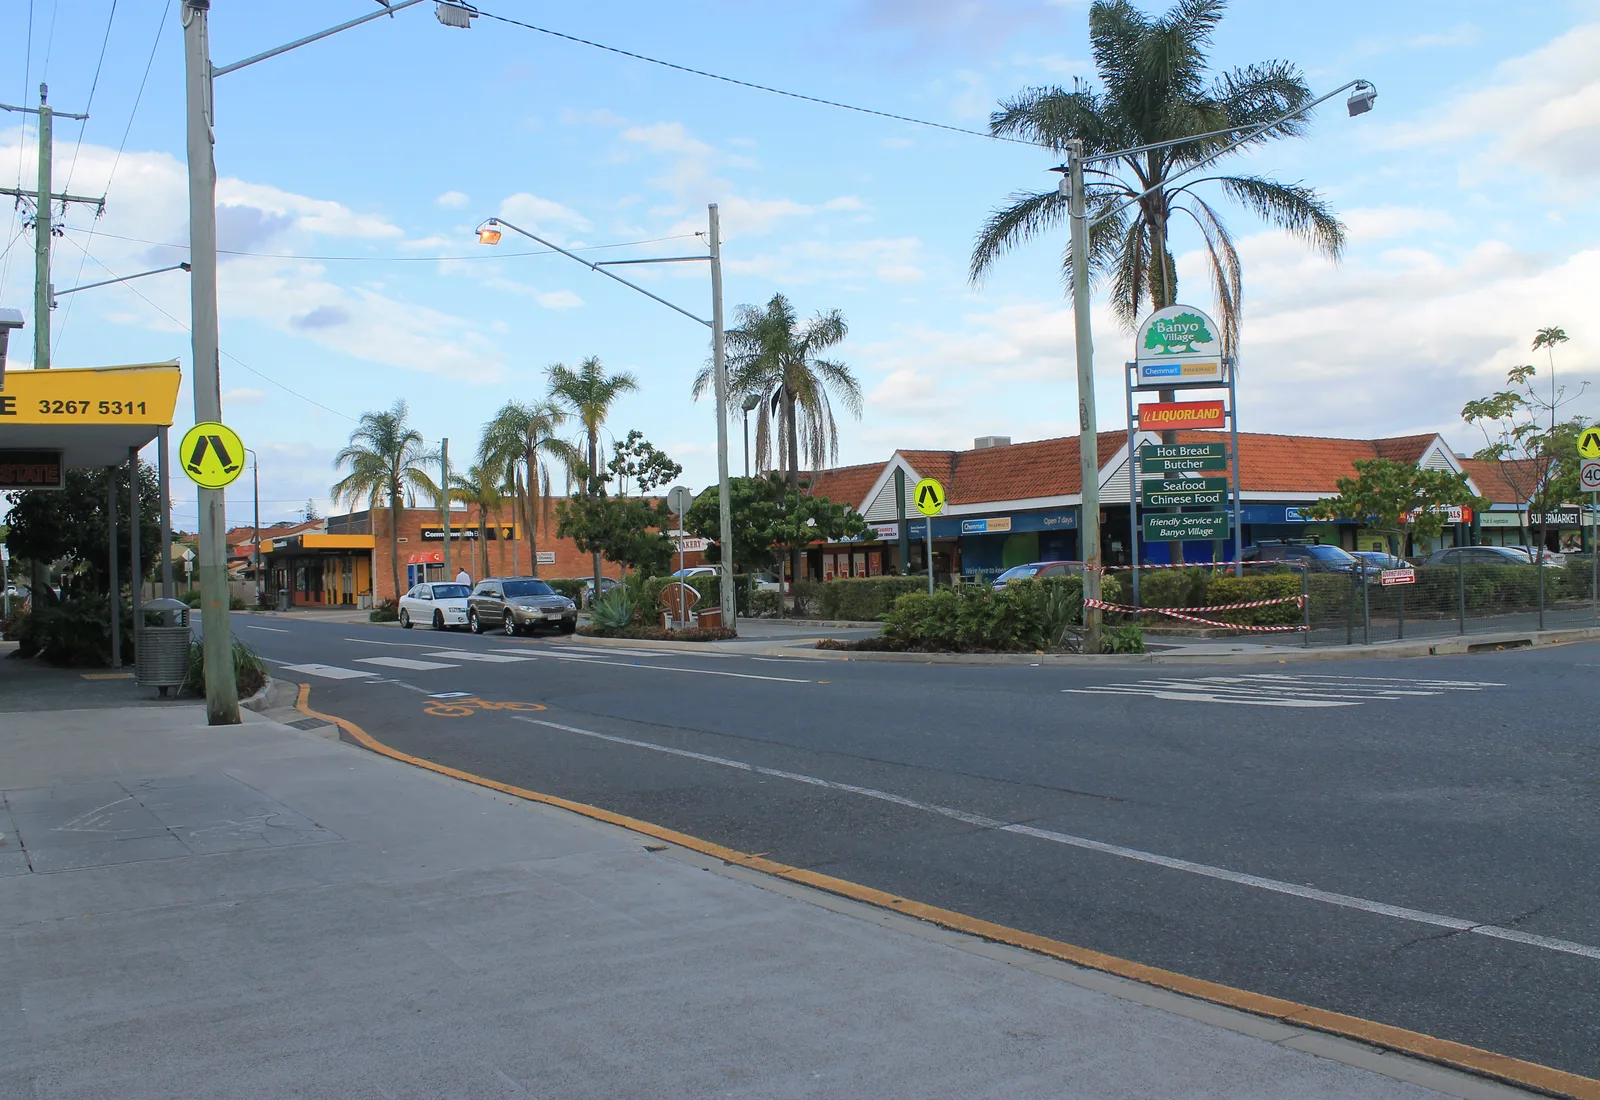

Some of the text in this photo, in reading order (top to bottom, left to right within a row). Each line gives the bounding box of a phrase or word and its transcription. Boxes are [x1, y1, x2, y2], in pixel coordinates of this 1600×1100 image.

[1156, 322, 1199, 334] Banyo
[1162, 333, 1195, 342] Village
[1145, 367, 1178, 375] Chemmart
[39, 400, 91, 415] 3267
[98, 401, 146, 415] 5311
[1151, 408, 1220, 422] LIQUORLAND
[1157, 446, 1210, 457] Hot Bread
[1164, 460, 1204, 469] Butcher
[1163, 480, 1206, 491] Seafood
[1150, 493, 1220, 505] Chinese Food
[1043, 516, 1073, 526] Open 7 days
[1149, 516, 1222, 527] Friendly Service at
[1530, 513, 1578, 524] SUERMARKET
[964, 522, 985, 530] Chemmart
[1159, 527, 1214, 537] Banyo Village
[679, 540, 702, 549] AKERY
